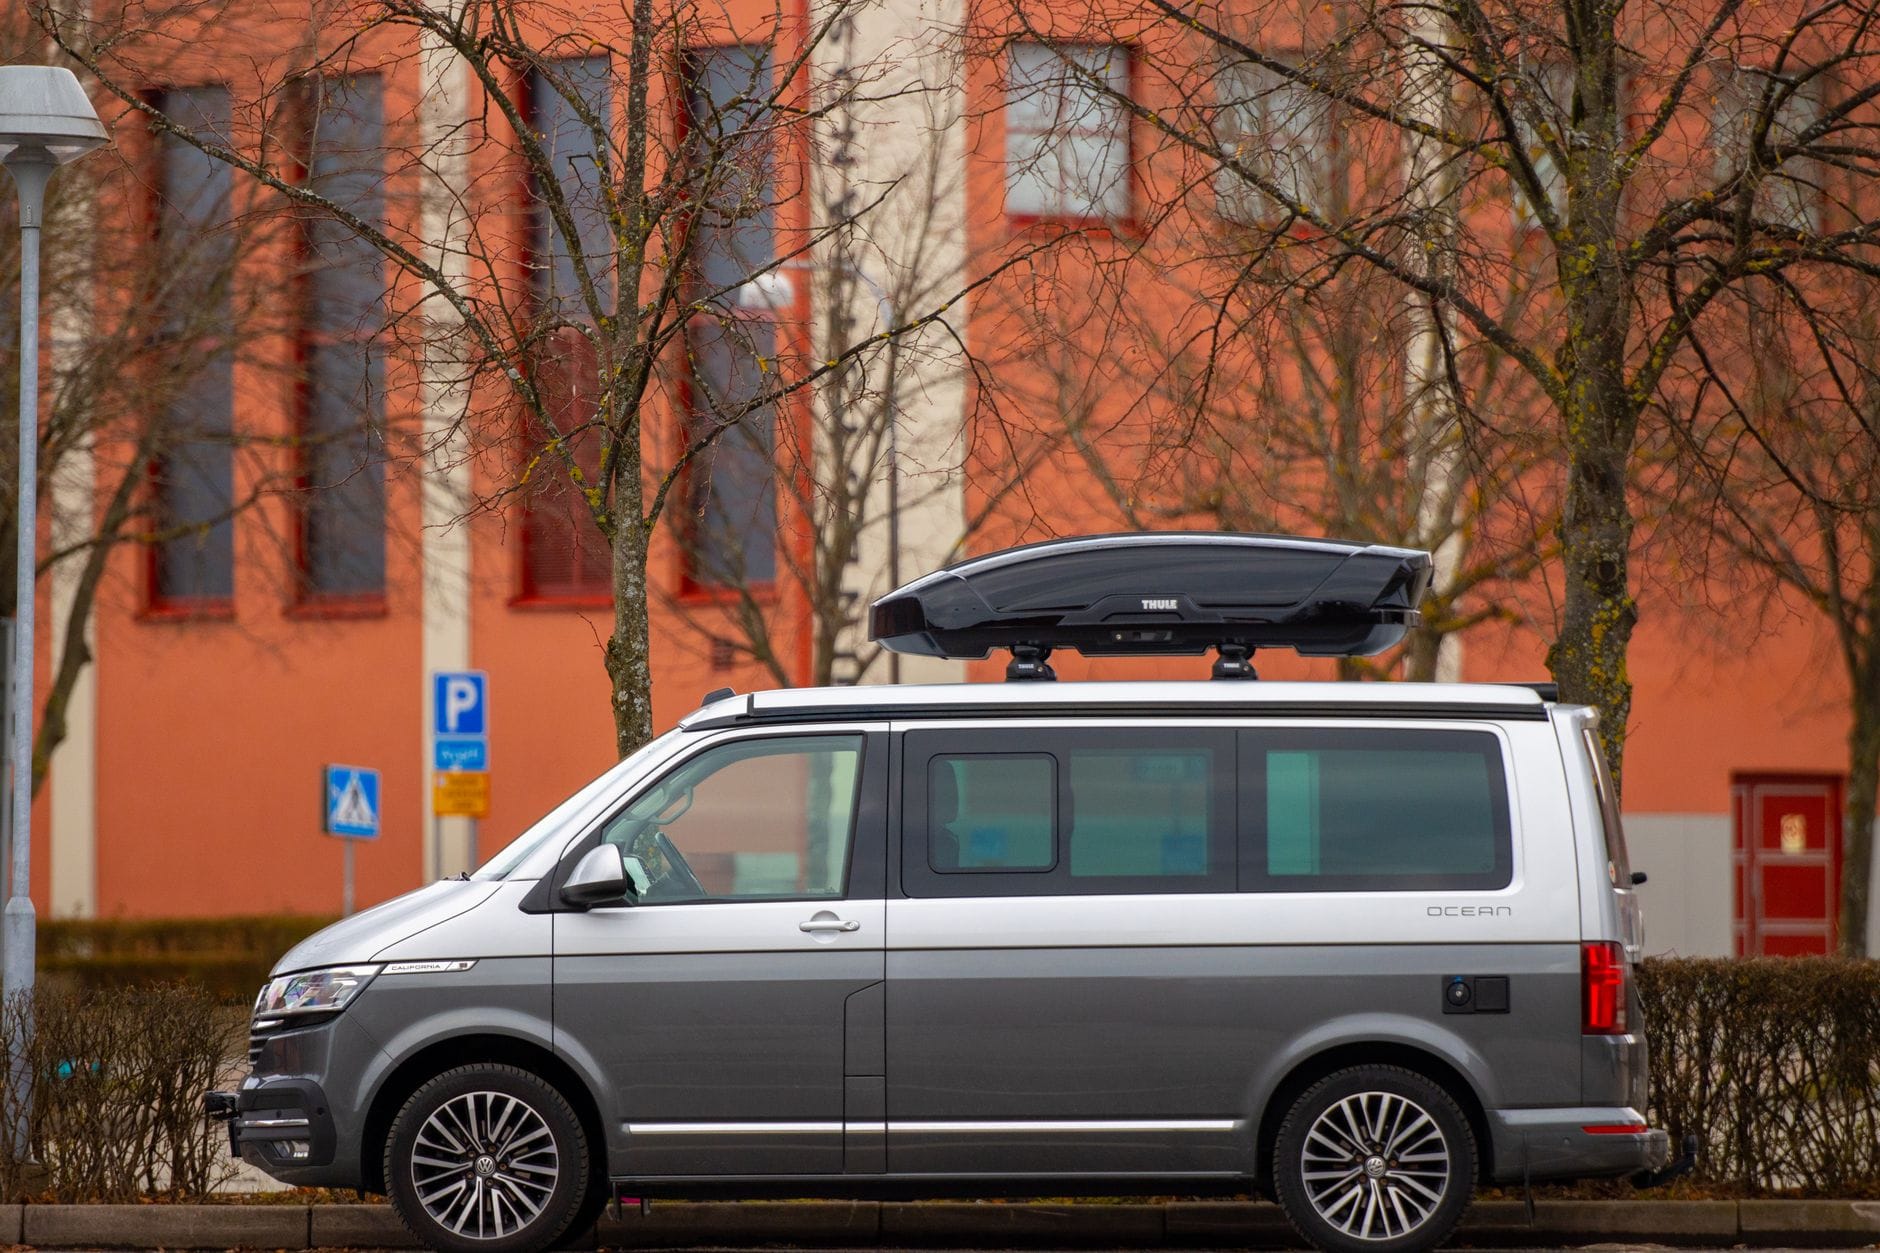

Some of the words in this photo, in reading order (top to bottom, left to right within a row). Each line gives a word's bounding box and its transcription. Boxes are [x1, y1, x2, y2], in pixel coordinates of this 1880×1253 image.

[1141, 599, 1178, 610] THULE
[447, 678, 478, 731] P
[1426, 906, 1512, 917] OCEAN
